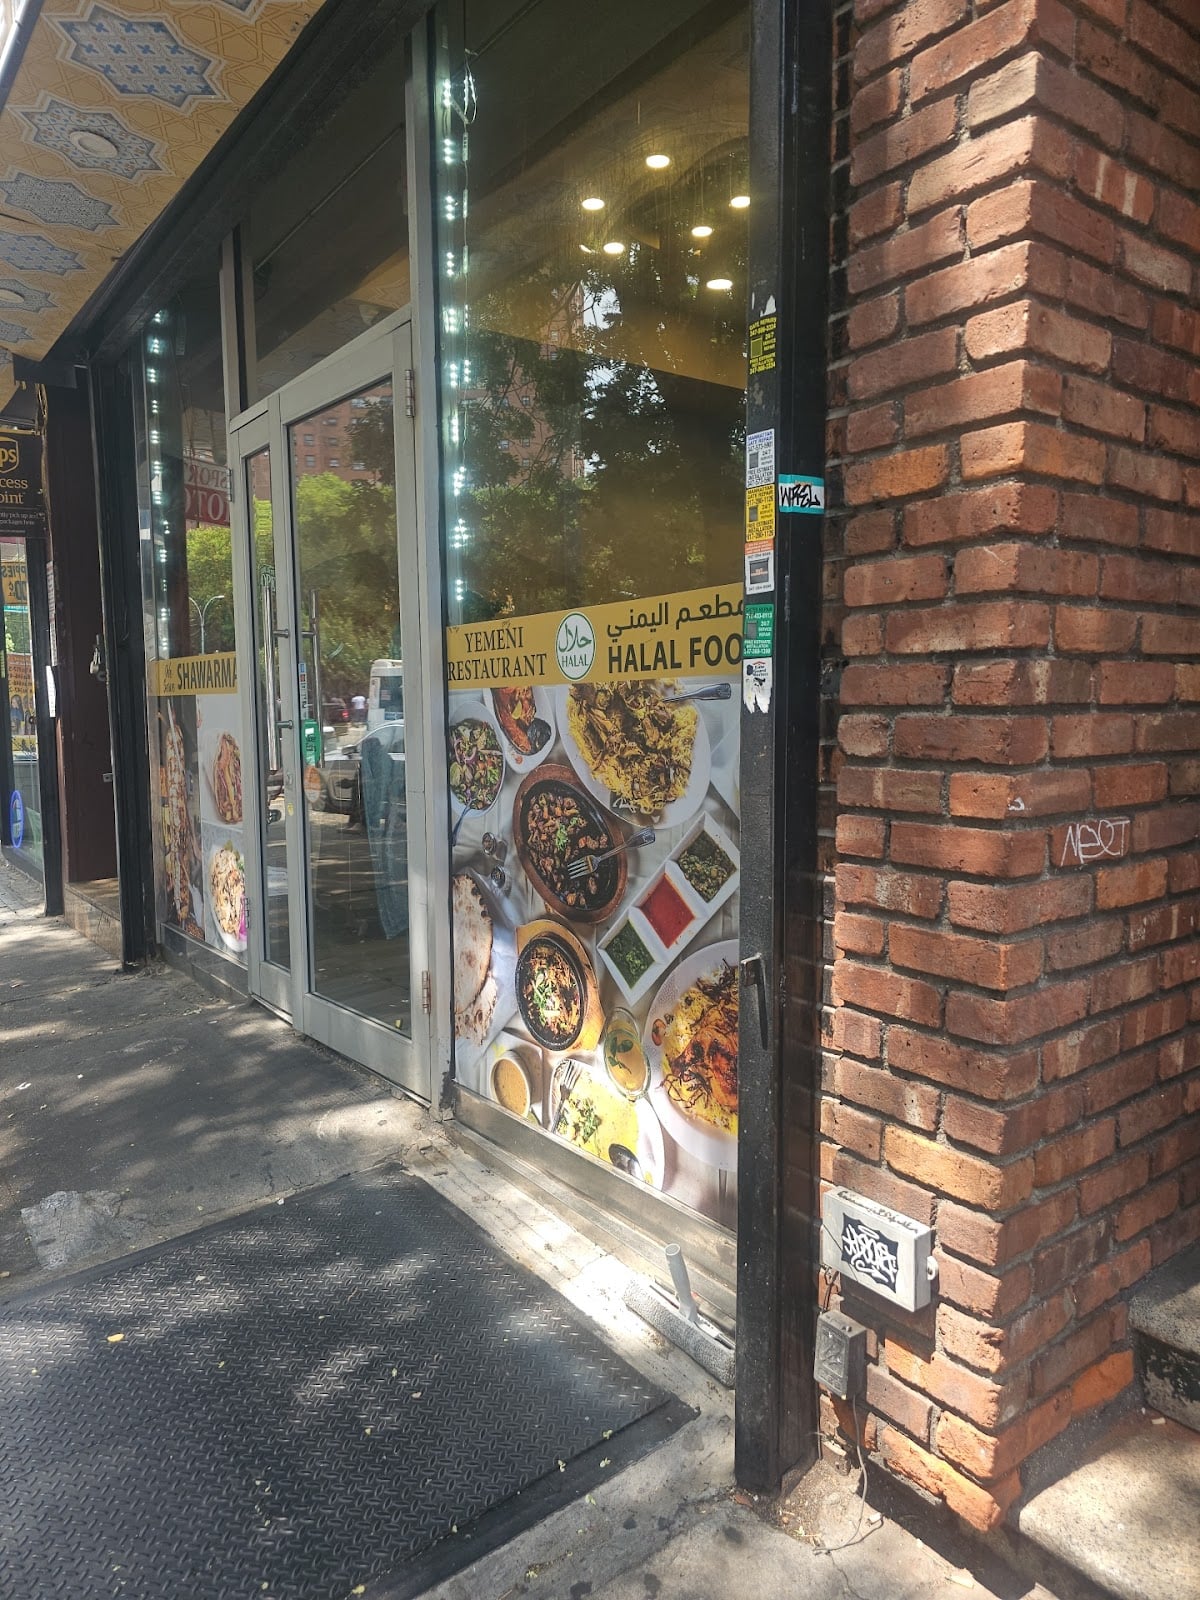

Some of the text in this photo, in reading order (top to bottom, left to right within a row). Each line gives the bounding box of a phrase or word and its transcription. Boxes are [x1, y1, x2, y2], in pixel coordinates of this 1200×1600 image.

[607, 602, 669, 640] اليمني
[464, 626, 524, 653] YEMENI
[447, 652, 547, 682] RESTAURANT
[561, 655, 590, 668] HALAL
[608, 640, 682, 674] HALAL
